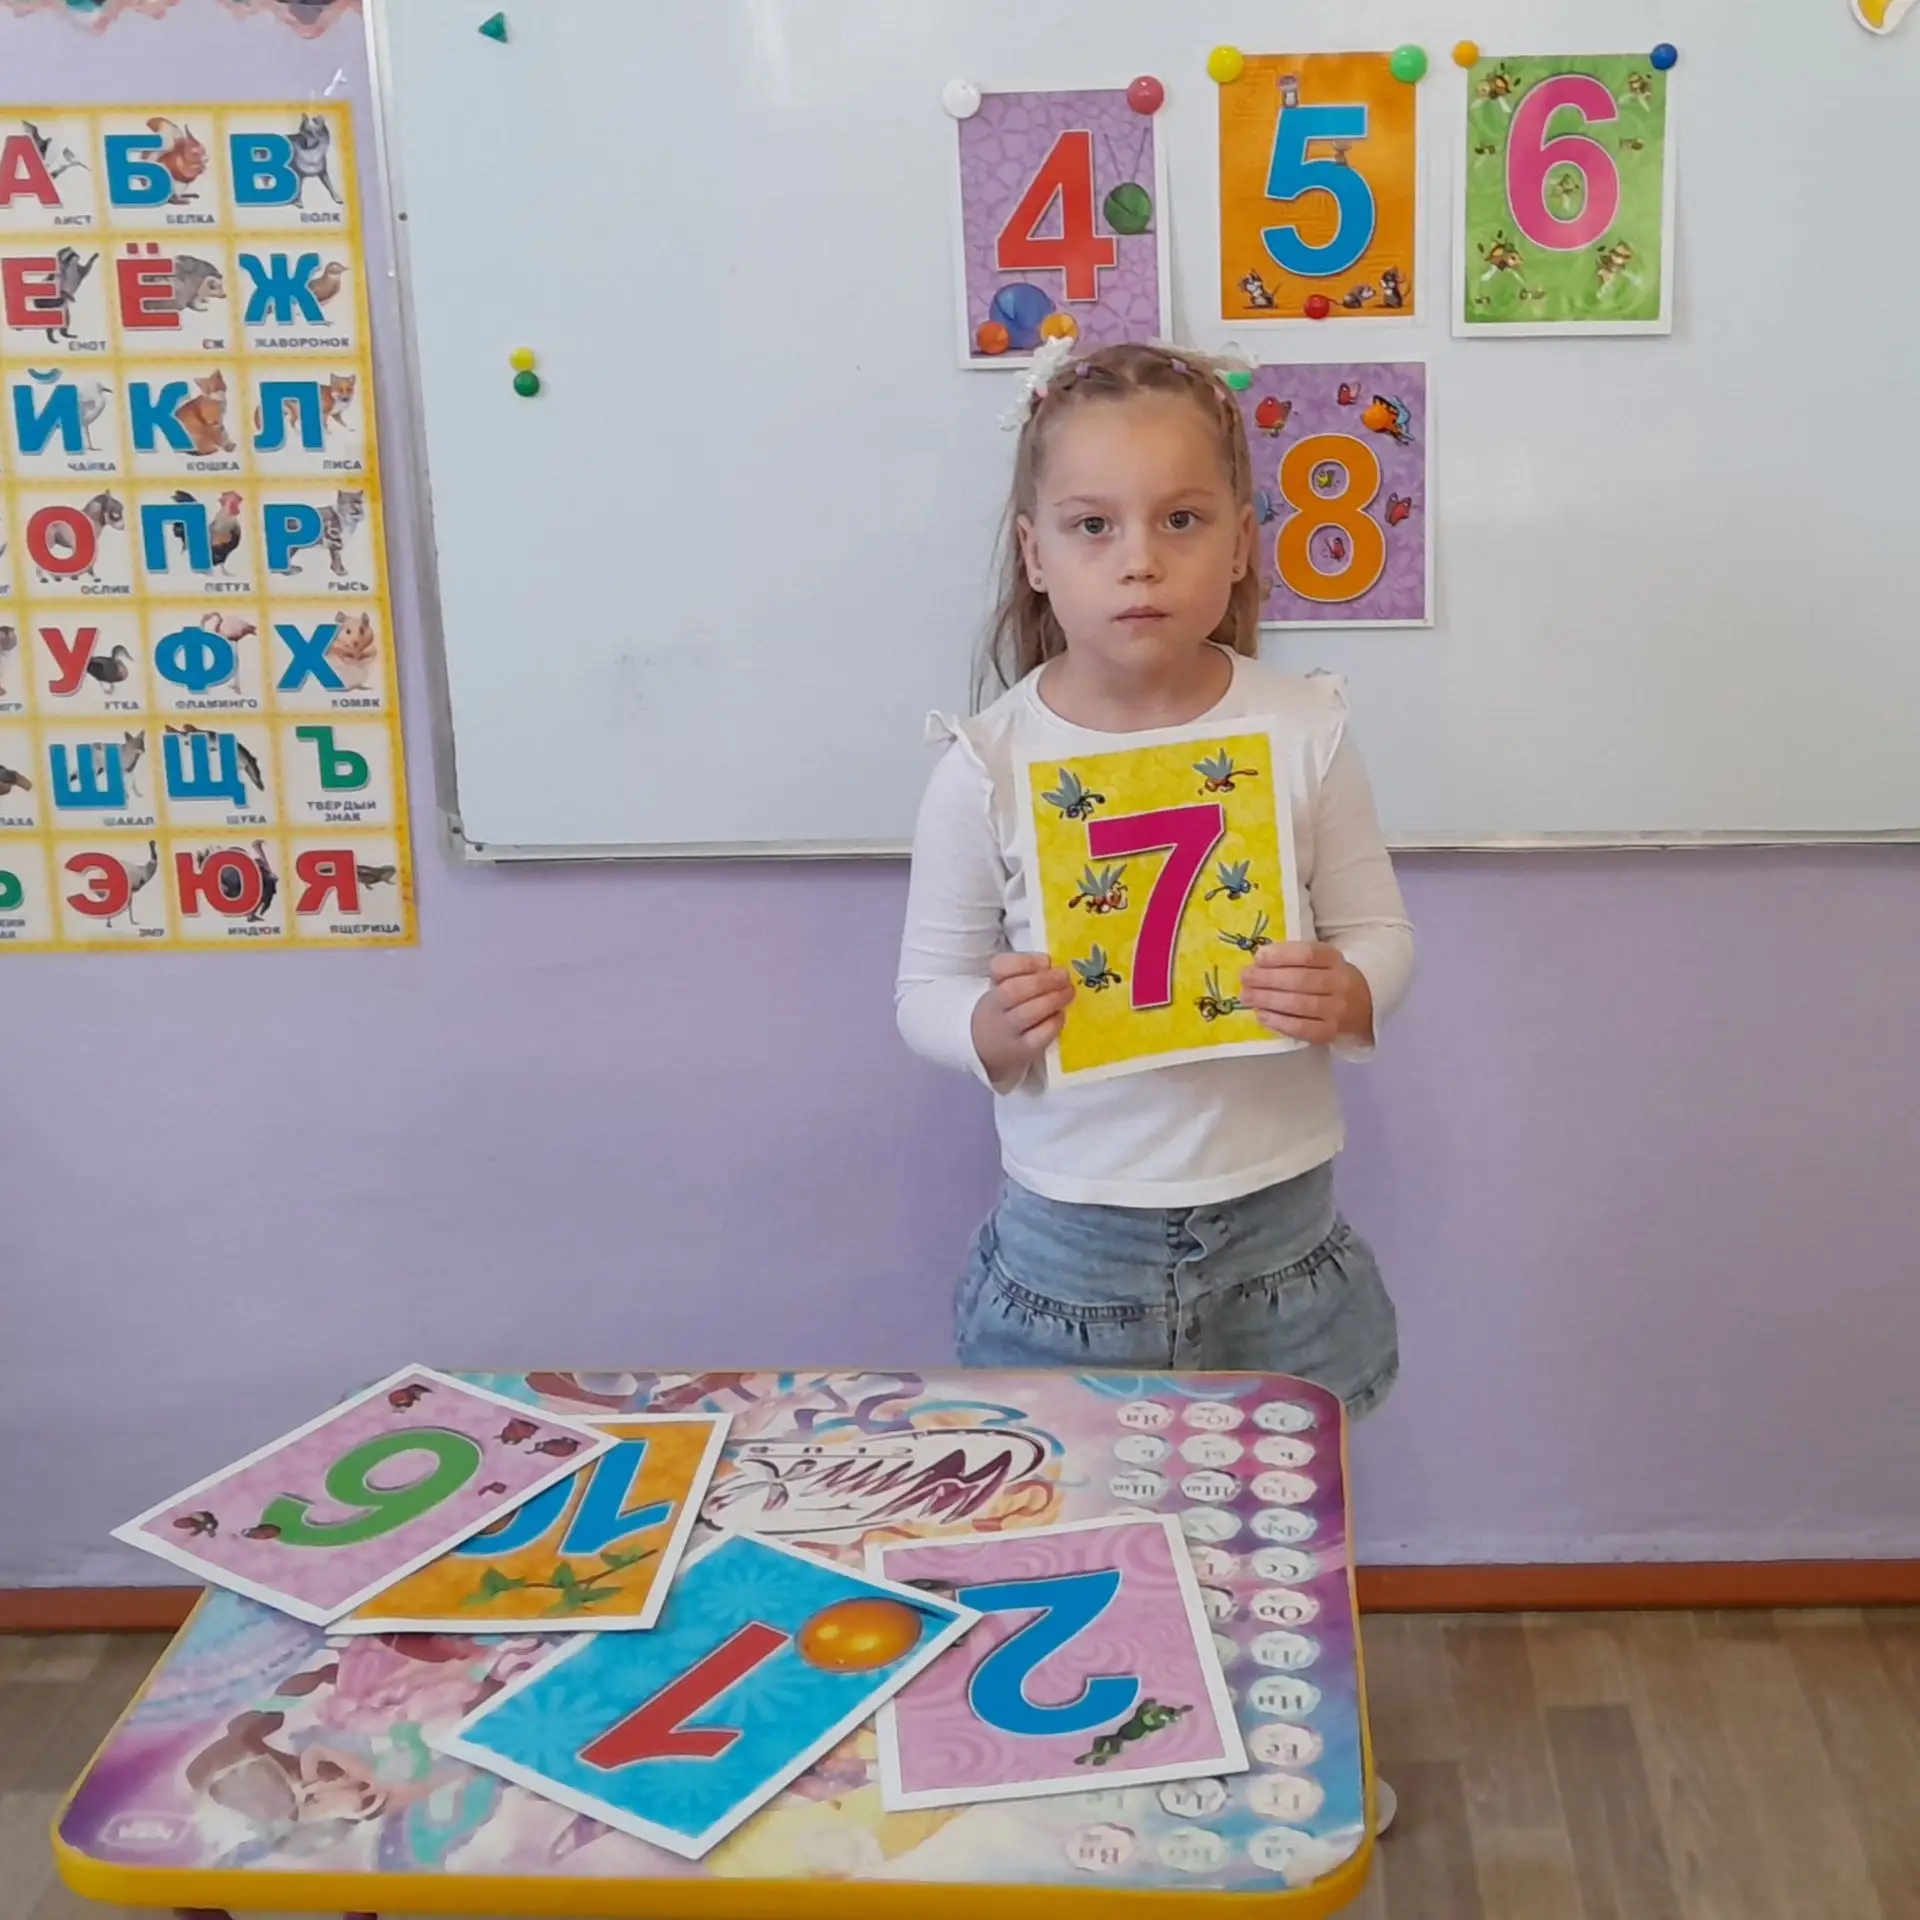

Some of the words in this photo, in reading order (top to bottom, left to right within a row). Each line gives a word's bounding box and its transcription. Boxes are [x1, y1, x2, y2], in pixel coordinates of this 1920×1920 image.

[0, 135, 62, 206] А
[105, 134, 172, 205] Б
[230, 134, 298, 204] В
[1263, 106, 1375, 276] 5
[1506, 75, 1619, 251] 6
[996, 130, 1116, 301] 4
[2, 257, 65, 327] Е
[117, 243, 181, 328] Ё
[238, 254, 323, 322] Ж
[254, 336, 350, 349] ЖАВОРОНОК
[13, 368, 83, 452] Й
[129, 382, 191, 450] К
[255, 381, 323, 449] Л
[26, 508, 96, 574] О
[141, 503, 211, 571] П
[263, 503, 322, 570] Р
[1276, 434, 1384, 601] 8
[80, 583, 131, 595] ОСЛИК
[204, 581, 251, 593] ПЕТУХ
[327, 580, 369, 592] РЫСЬ
[38, 628, 99, 696] У
[155, 627, 235, 692] Ф
[273, 624, 346, 693] Х
[174, 698, 259, 710] ФЛАМИНГО
[51, 745, 126, 808] Ш
[164, 734, 247, 806] Щ
[297, 726, 369, 789] Ъ
[65, 852, 130, 916] Э
[175, 850, 261, 914] Ю
[295, 849, 359, 913] Я
[1086, 803, 1223, 1008] 7
[958, 1571, 1139, 1736] 2
[585, 1624, 786, 1767] 1
